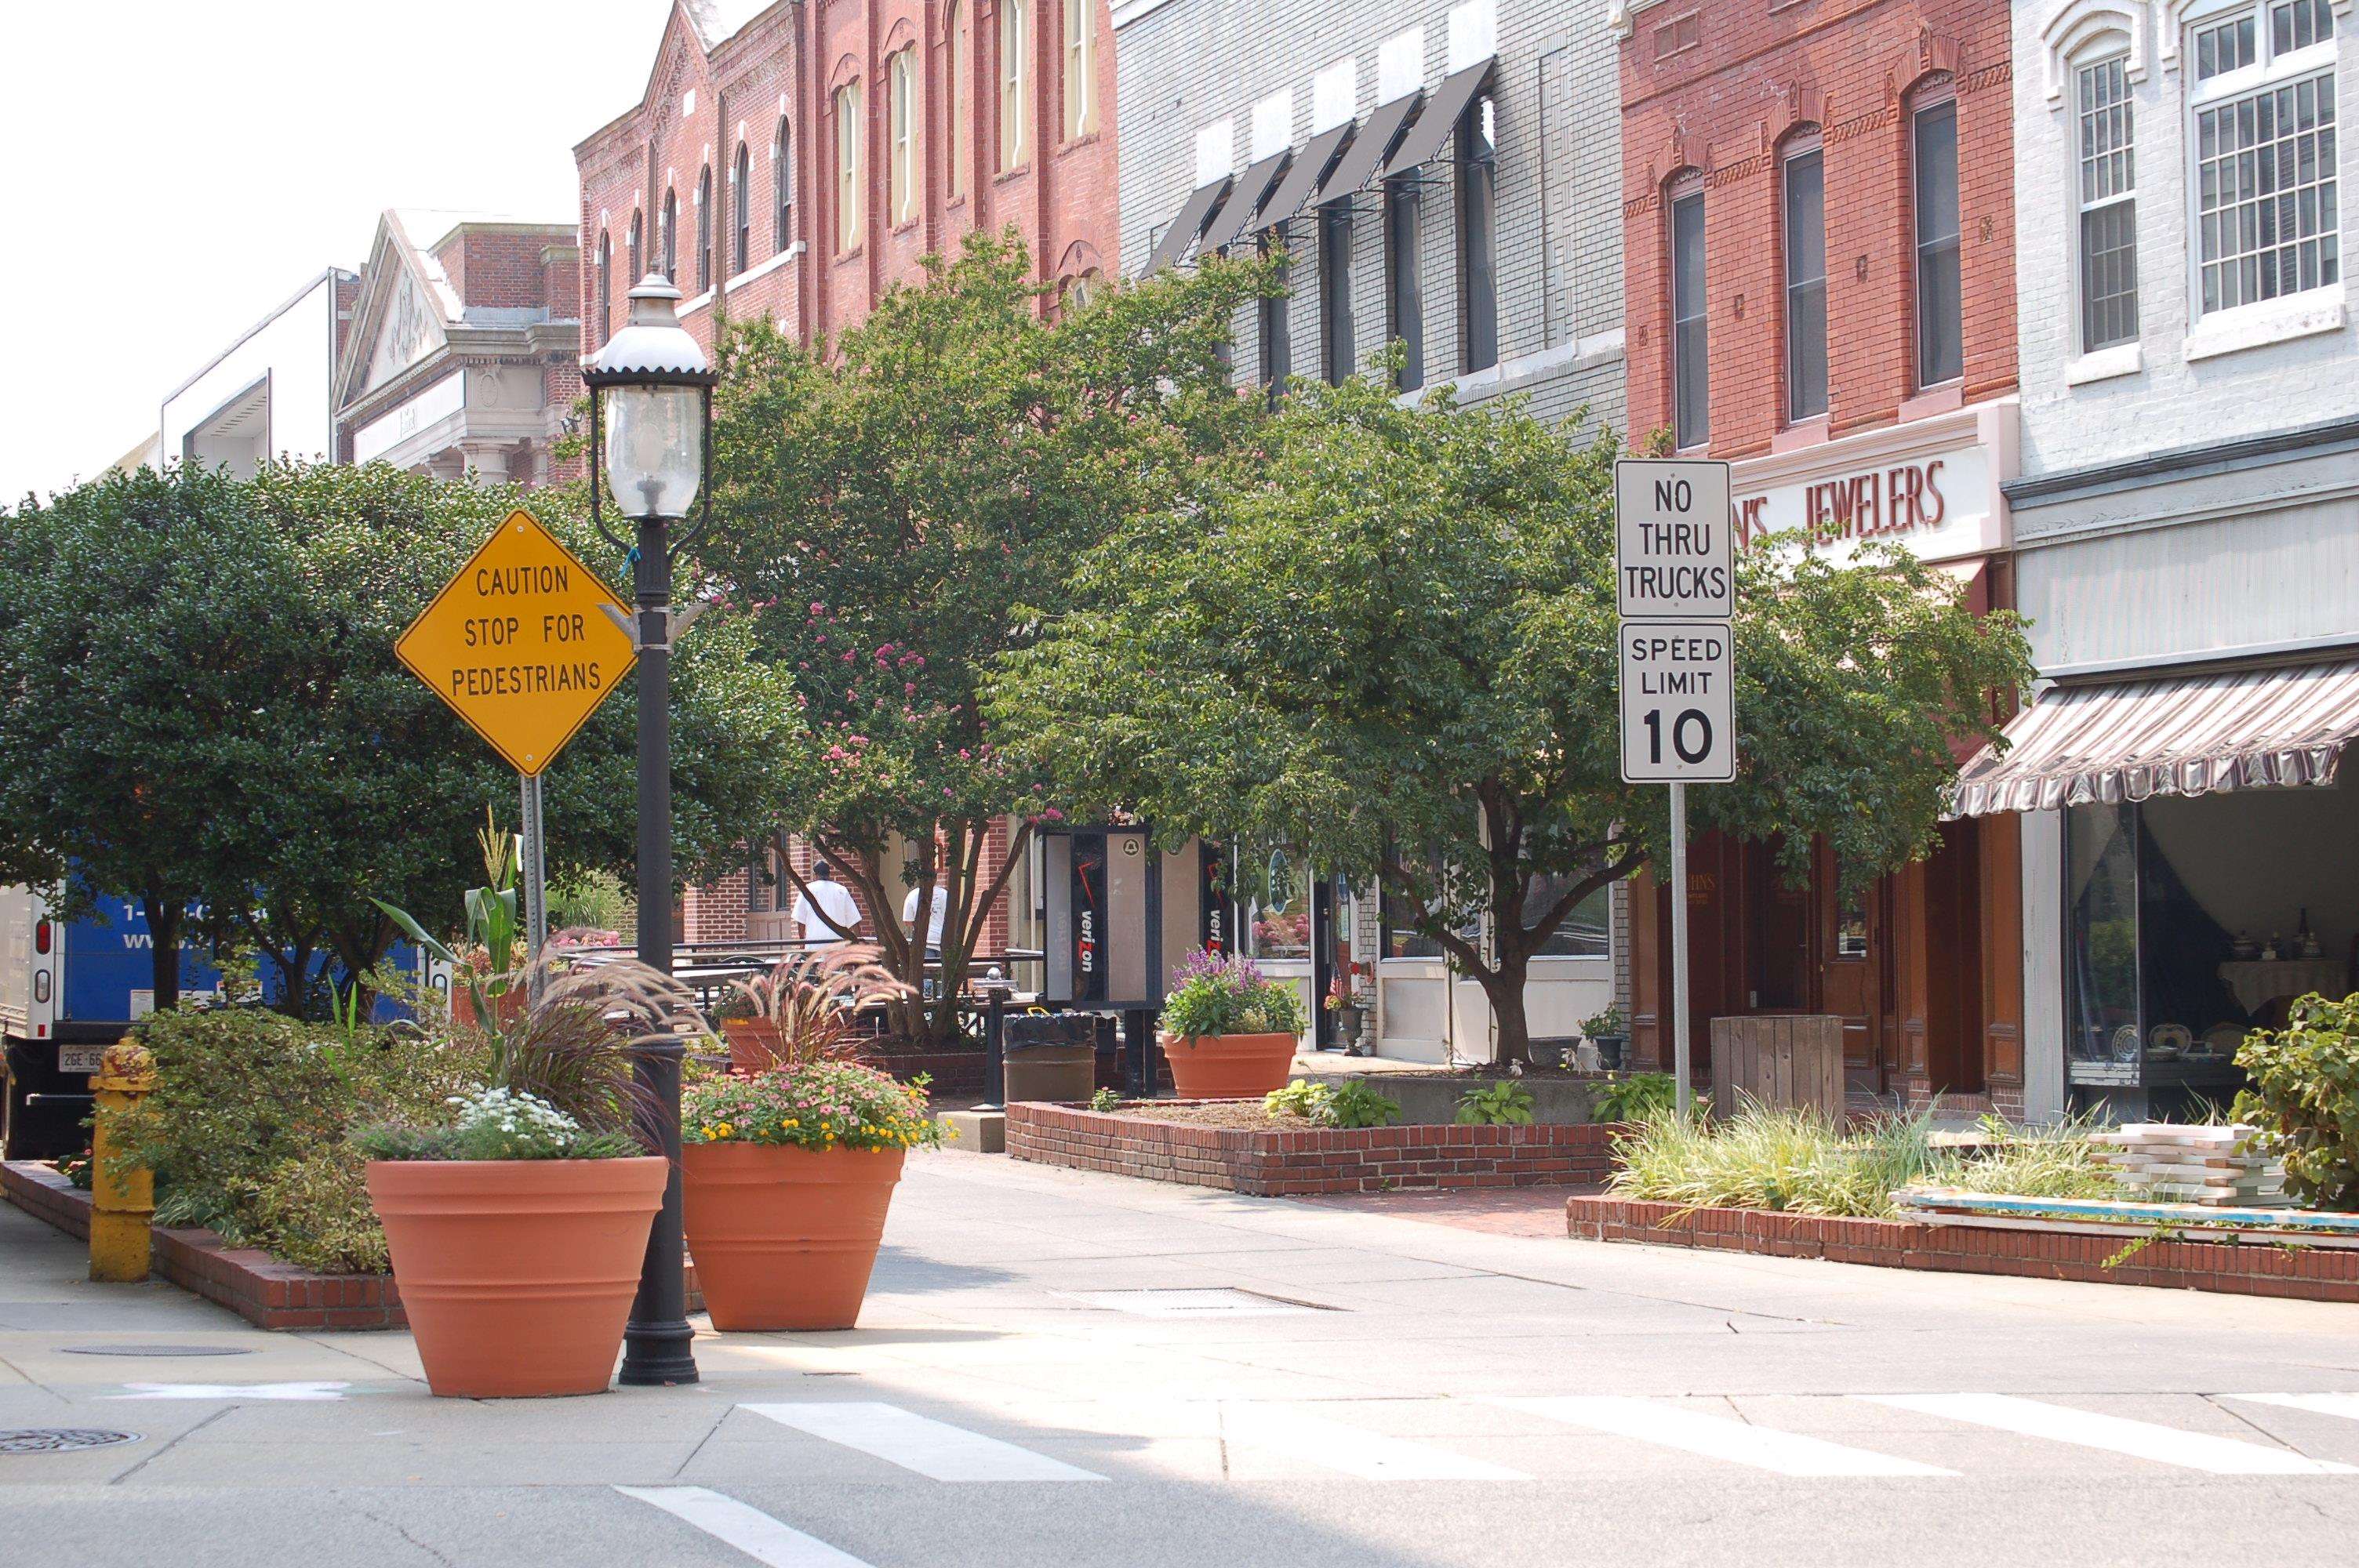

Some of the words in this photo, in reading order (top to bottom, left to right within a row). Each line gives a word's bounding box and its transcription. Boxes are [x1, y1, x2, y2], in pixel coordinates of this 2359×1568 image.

[1655, 479, 1692, 513] NO
[1806, 461, 1944, 545] JEWELERS
[1638, 523, 1710, 556] THRU
[476, 564, 569, 597] CAUTION
[1624, 566, 1726, 599] TRUCKS
[464, 617, 519, 647] STOP
[543, 614, 585, 643] FOR
[1631, 638, 1722, 662] SPEED
[452, 662, 601, 697] PEDESTRIANS
[1641, 672, 1713, 695] LIMIT
[1643, 708, 1713, 764] 10
[1078, 909, 1096, 972] verizon
